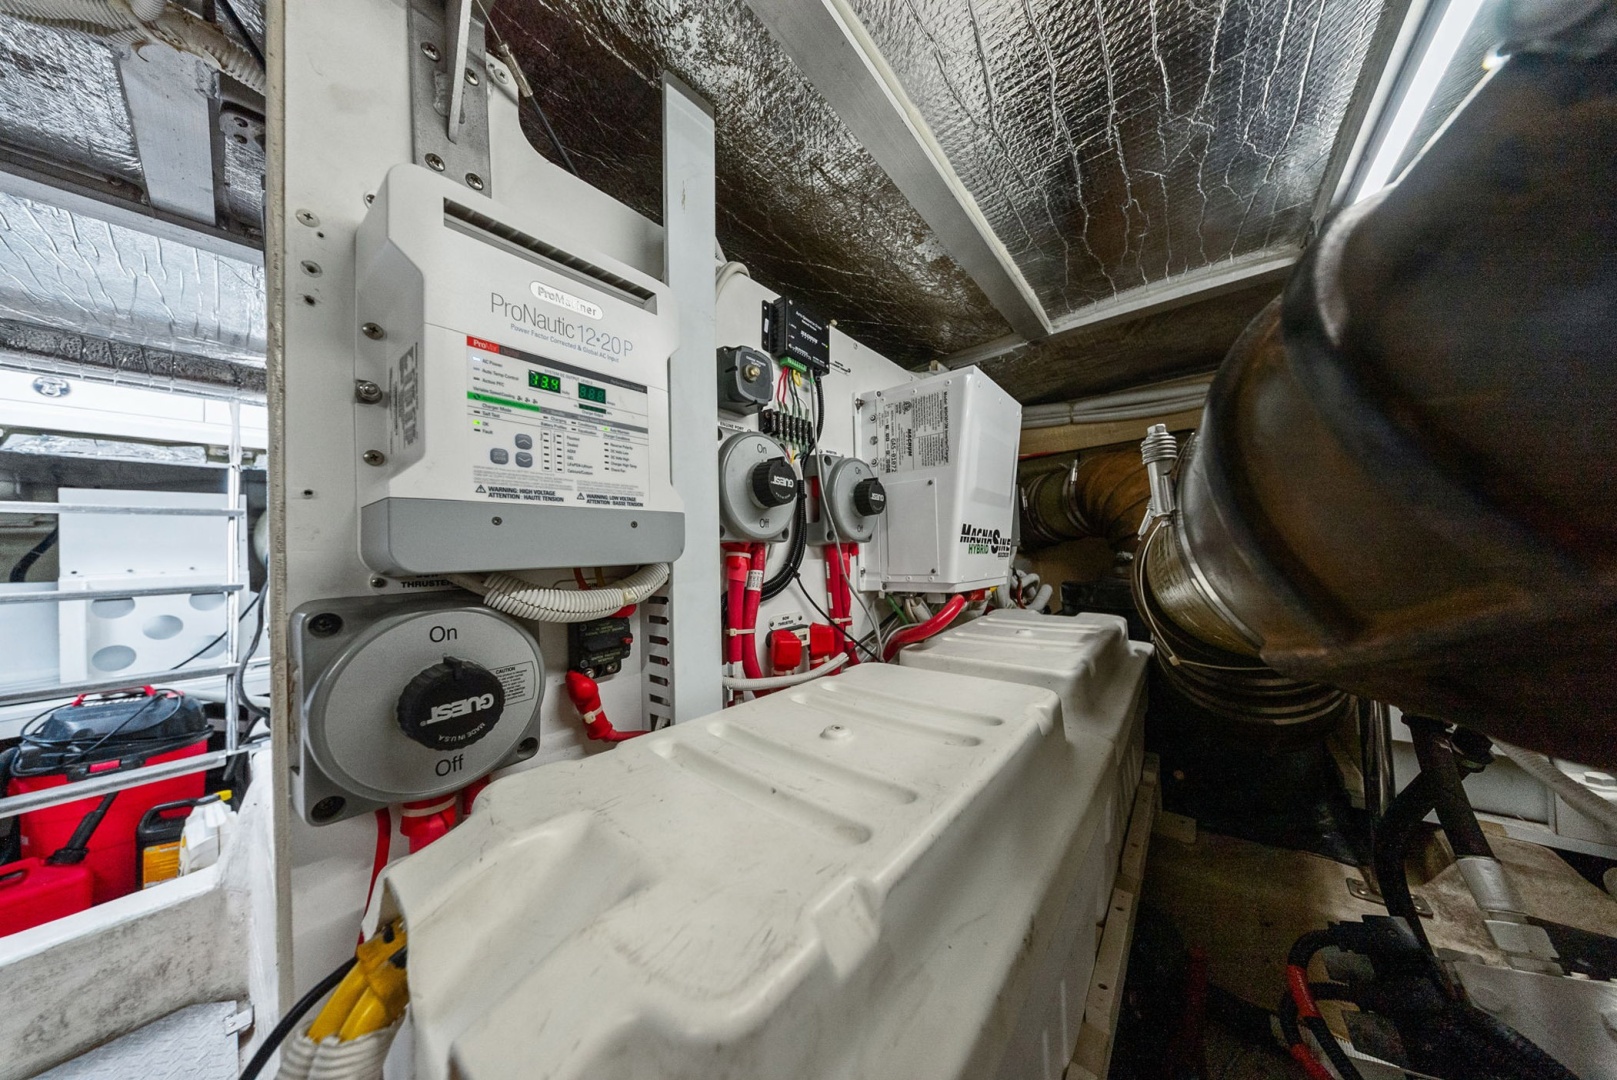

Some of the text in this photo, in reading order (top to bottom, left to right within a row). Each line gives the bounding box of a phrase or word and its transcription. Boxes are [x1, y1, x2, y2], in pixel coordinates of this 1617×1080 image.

[491, 292, 576, 339] ProNautic
[510, 323, 530, 337] Power
[530, 329, 550, 342] Factor
[550, 334, 577, 351] Corrected
[582, 346, 599, 358] Global
[607, 353, 620, 364] Input
[756, 443, 768, 455] On
[488, 492, 565, 503] ATTENTION HAUTE TENSION
[519, 488, 533, 496] HIGH
[533, 489, 556, 497] VOLTAGE
[759, 518, 770, 529] Off
[968, 543, 989, 555] HYBRID
[429, 626, 458, 643] On
[495, 666, 516, 675] CAUTION
[427, 693, 495, 724] GUEST
[467, 722, 486, 738] MADE
[435, 754, 464, 777] Off
